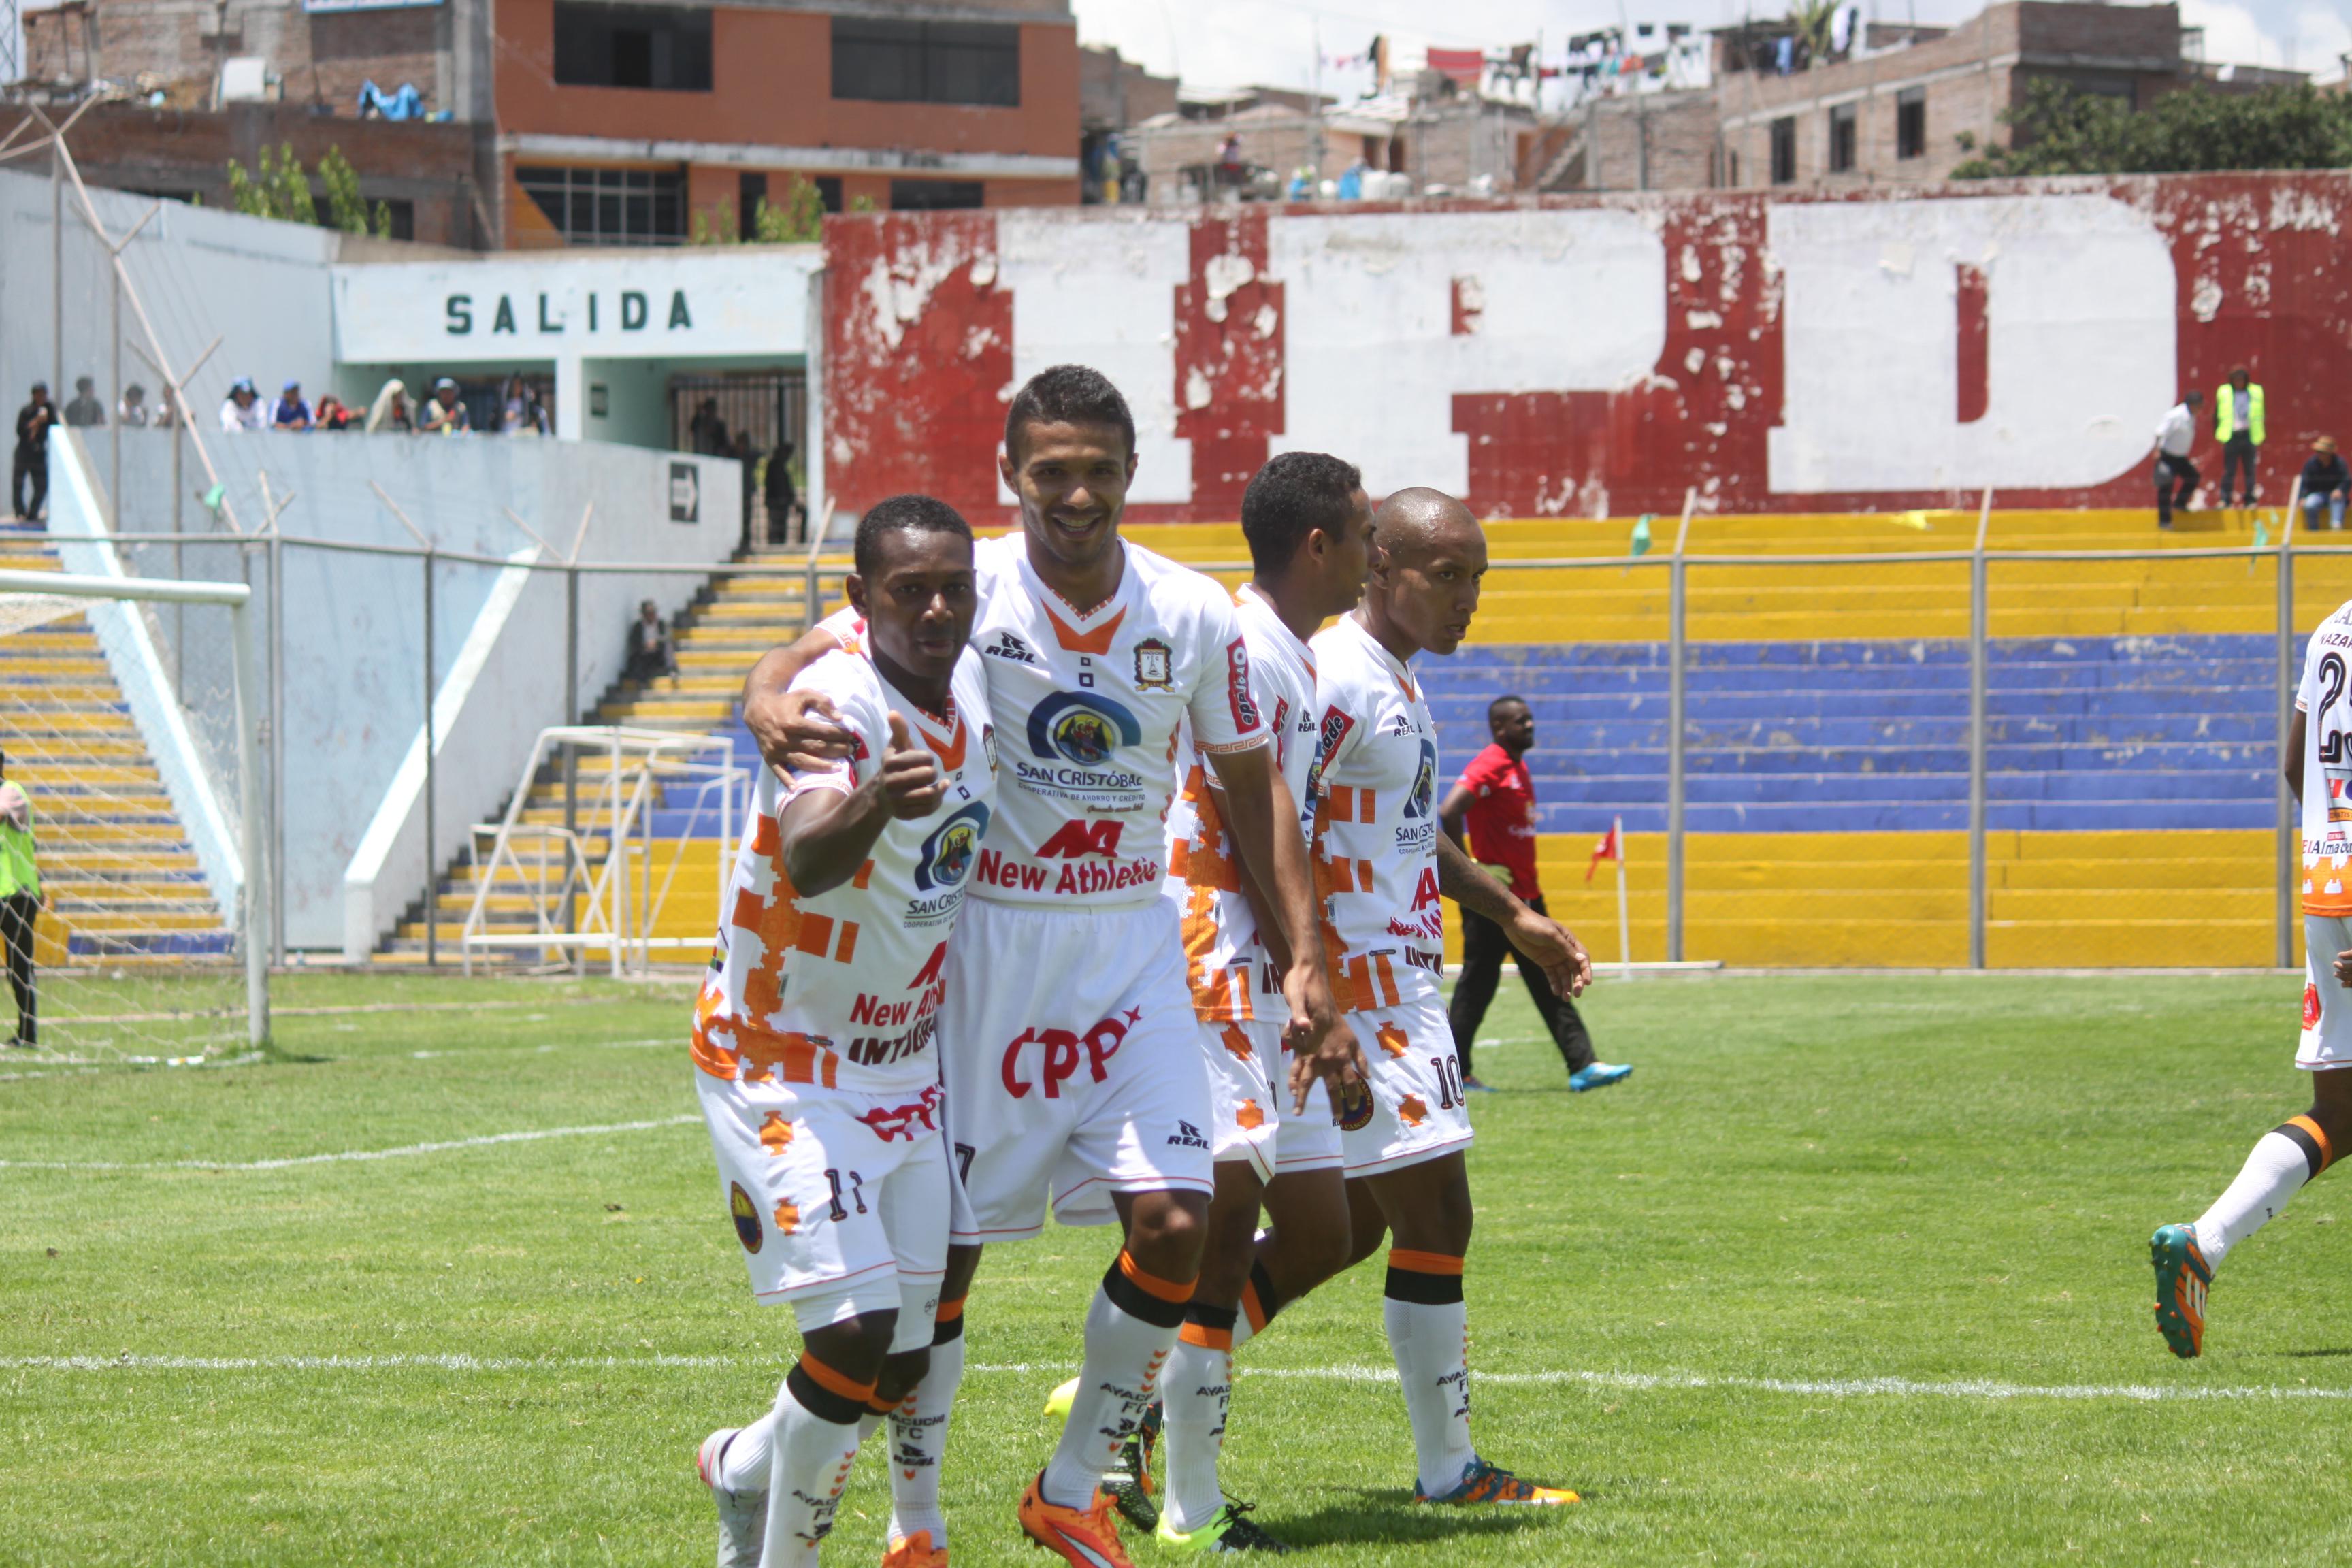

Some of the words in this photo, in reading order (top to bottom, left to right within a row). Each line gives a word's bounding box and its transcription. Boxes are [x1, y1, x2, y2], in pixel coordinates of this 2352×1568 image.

[446, 289, 692, 335] SALIDA
[996, 195, 2178, 504] IPD
[985, 645, 1035, 664] REAL
[2319, 651, 2352, 763] 2
[1298, 722, 1318, 732] REAL
[1394, 725, 1416, 737] REAL
[1017, 762, 1054, 782] SAN
[1396, 826, 1418, 841] SAN
[977, 848, 1048, 892] New
[1055, 856, 1158, 894] Athletic
[906, 899, 937, 914] SAN
[849, 992, 913, 1027] New
[1001, 1017, 1128, 1098] CPP
[1430, 1054, 1465, 1110] 10
[1166, 1134, 1210, 1150] REAL
[823, 1168, 868, 1222] 11
[1436, 1366, 1469, 1386] AYAC
[1100, 1382, 1155, 1402] AYACU
[1196, 1385, 1232, 1396] AYAC
[896, 1425, 924, 1440] FC
